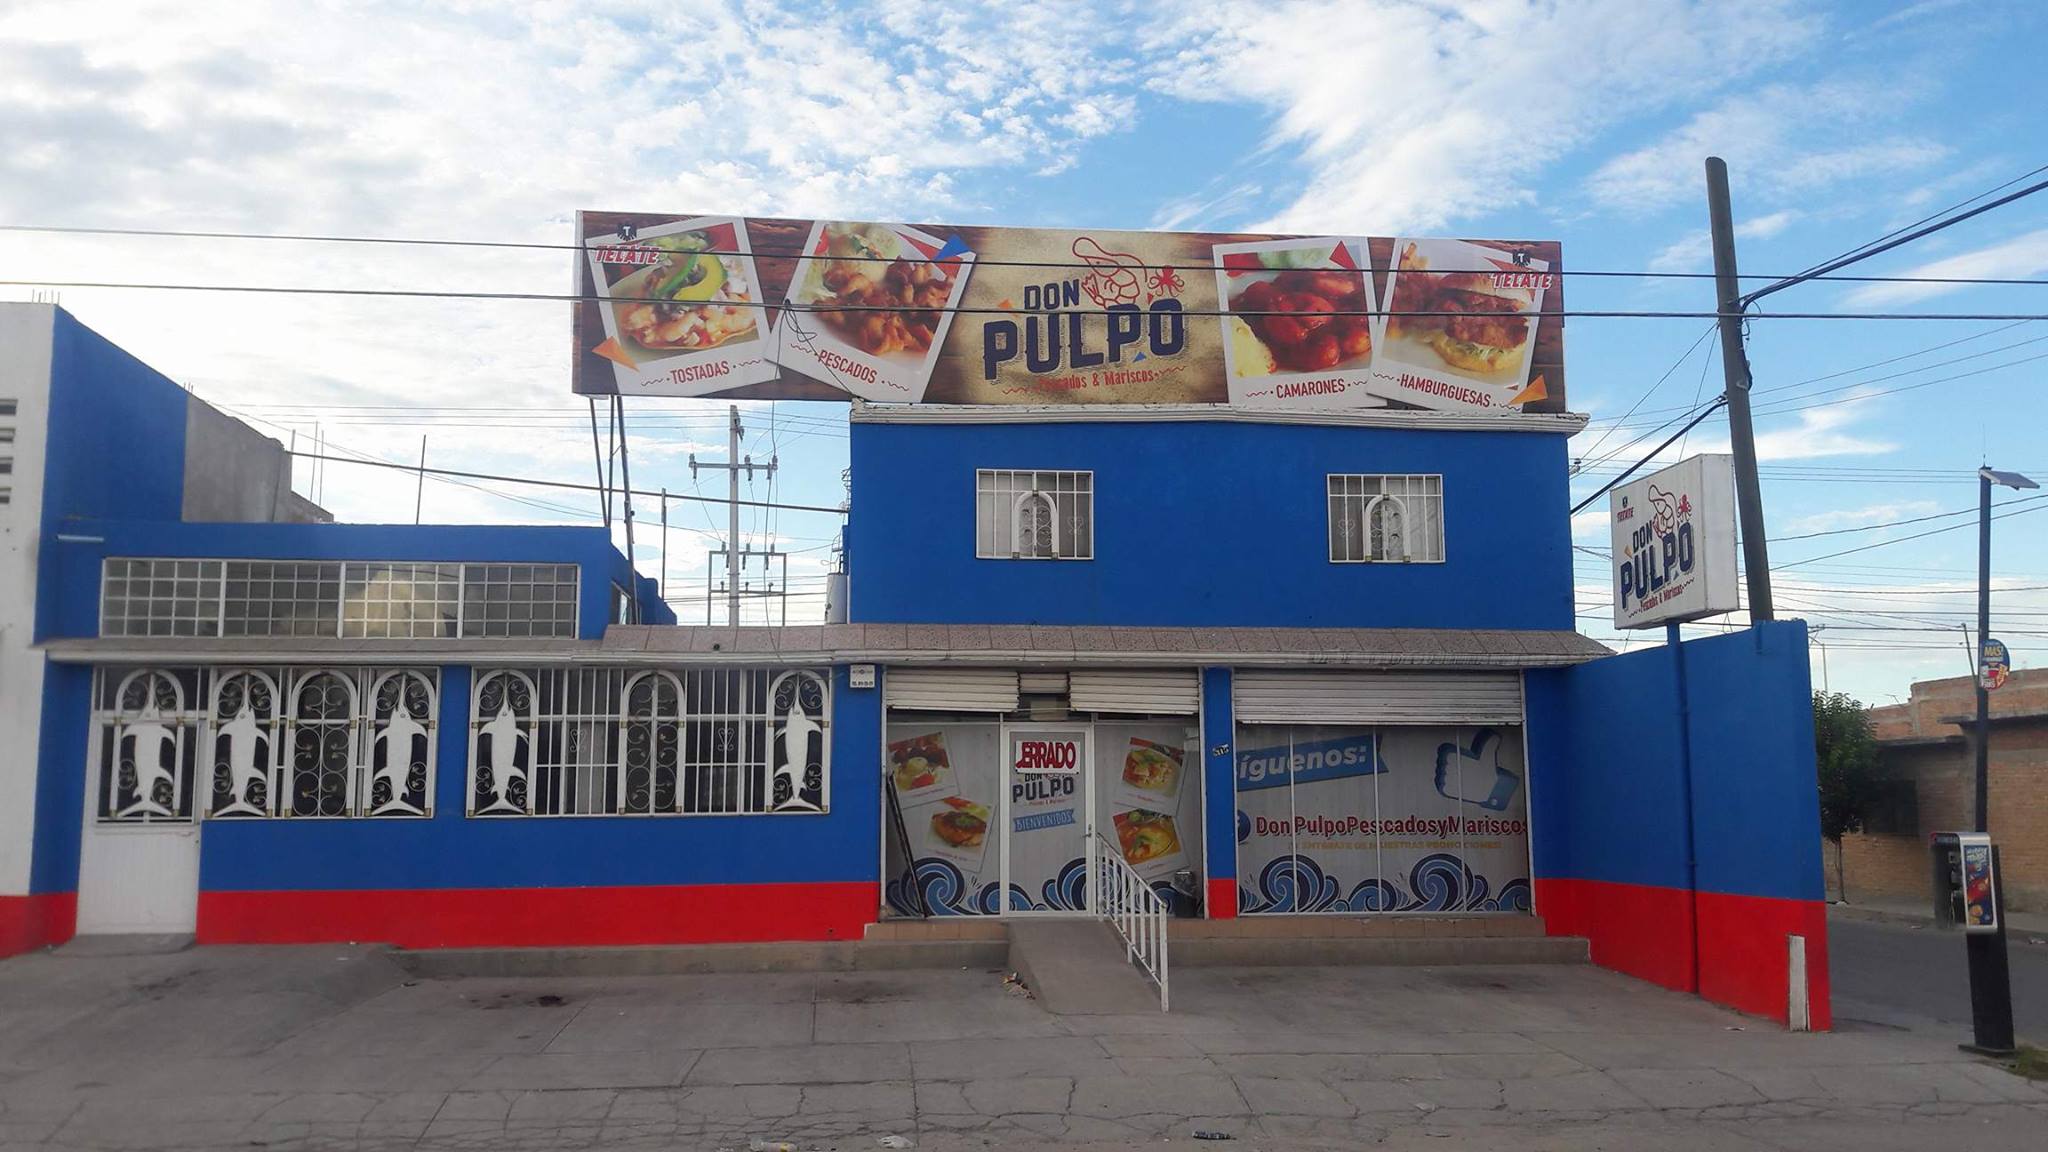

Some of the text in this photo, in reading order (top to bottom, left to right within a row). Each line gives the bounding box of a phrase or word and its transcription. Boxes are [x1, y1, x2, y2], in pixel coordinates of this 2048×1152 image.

[594, 244, 661, 264] TECATE
[1489, 270, 1552, 289] TECATE
[1024, 279, 1080, 310] DON
[983, 298, 1185, 380] PULPO
[669, 360, 730, 385] TOSTADAS
[817, 349, 878, 384] PESCADOS
[1091, 373, 1100, 387] &
[1104, 369, 1154, 387] Mariscos
[1276, 378, 1346, 399] CAMARONES
[1400, 373, 1492, 408] HAMBURGUESAS
[1632, 519, 1653, 554] DON
[1620, 521, 1694, 610] PULPO
[1012, 776, 1074, 803] PULPO
[1016, 810, 1074, 831] BIENVENIDOS
